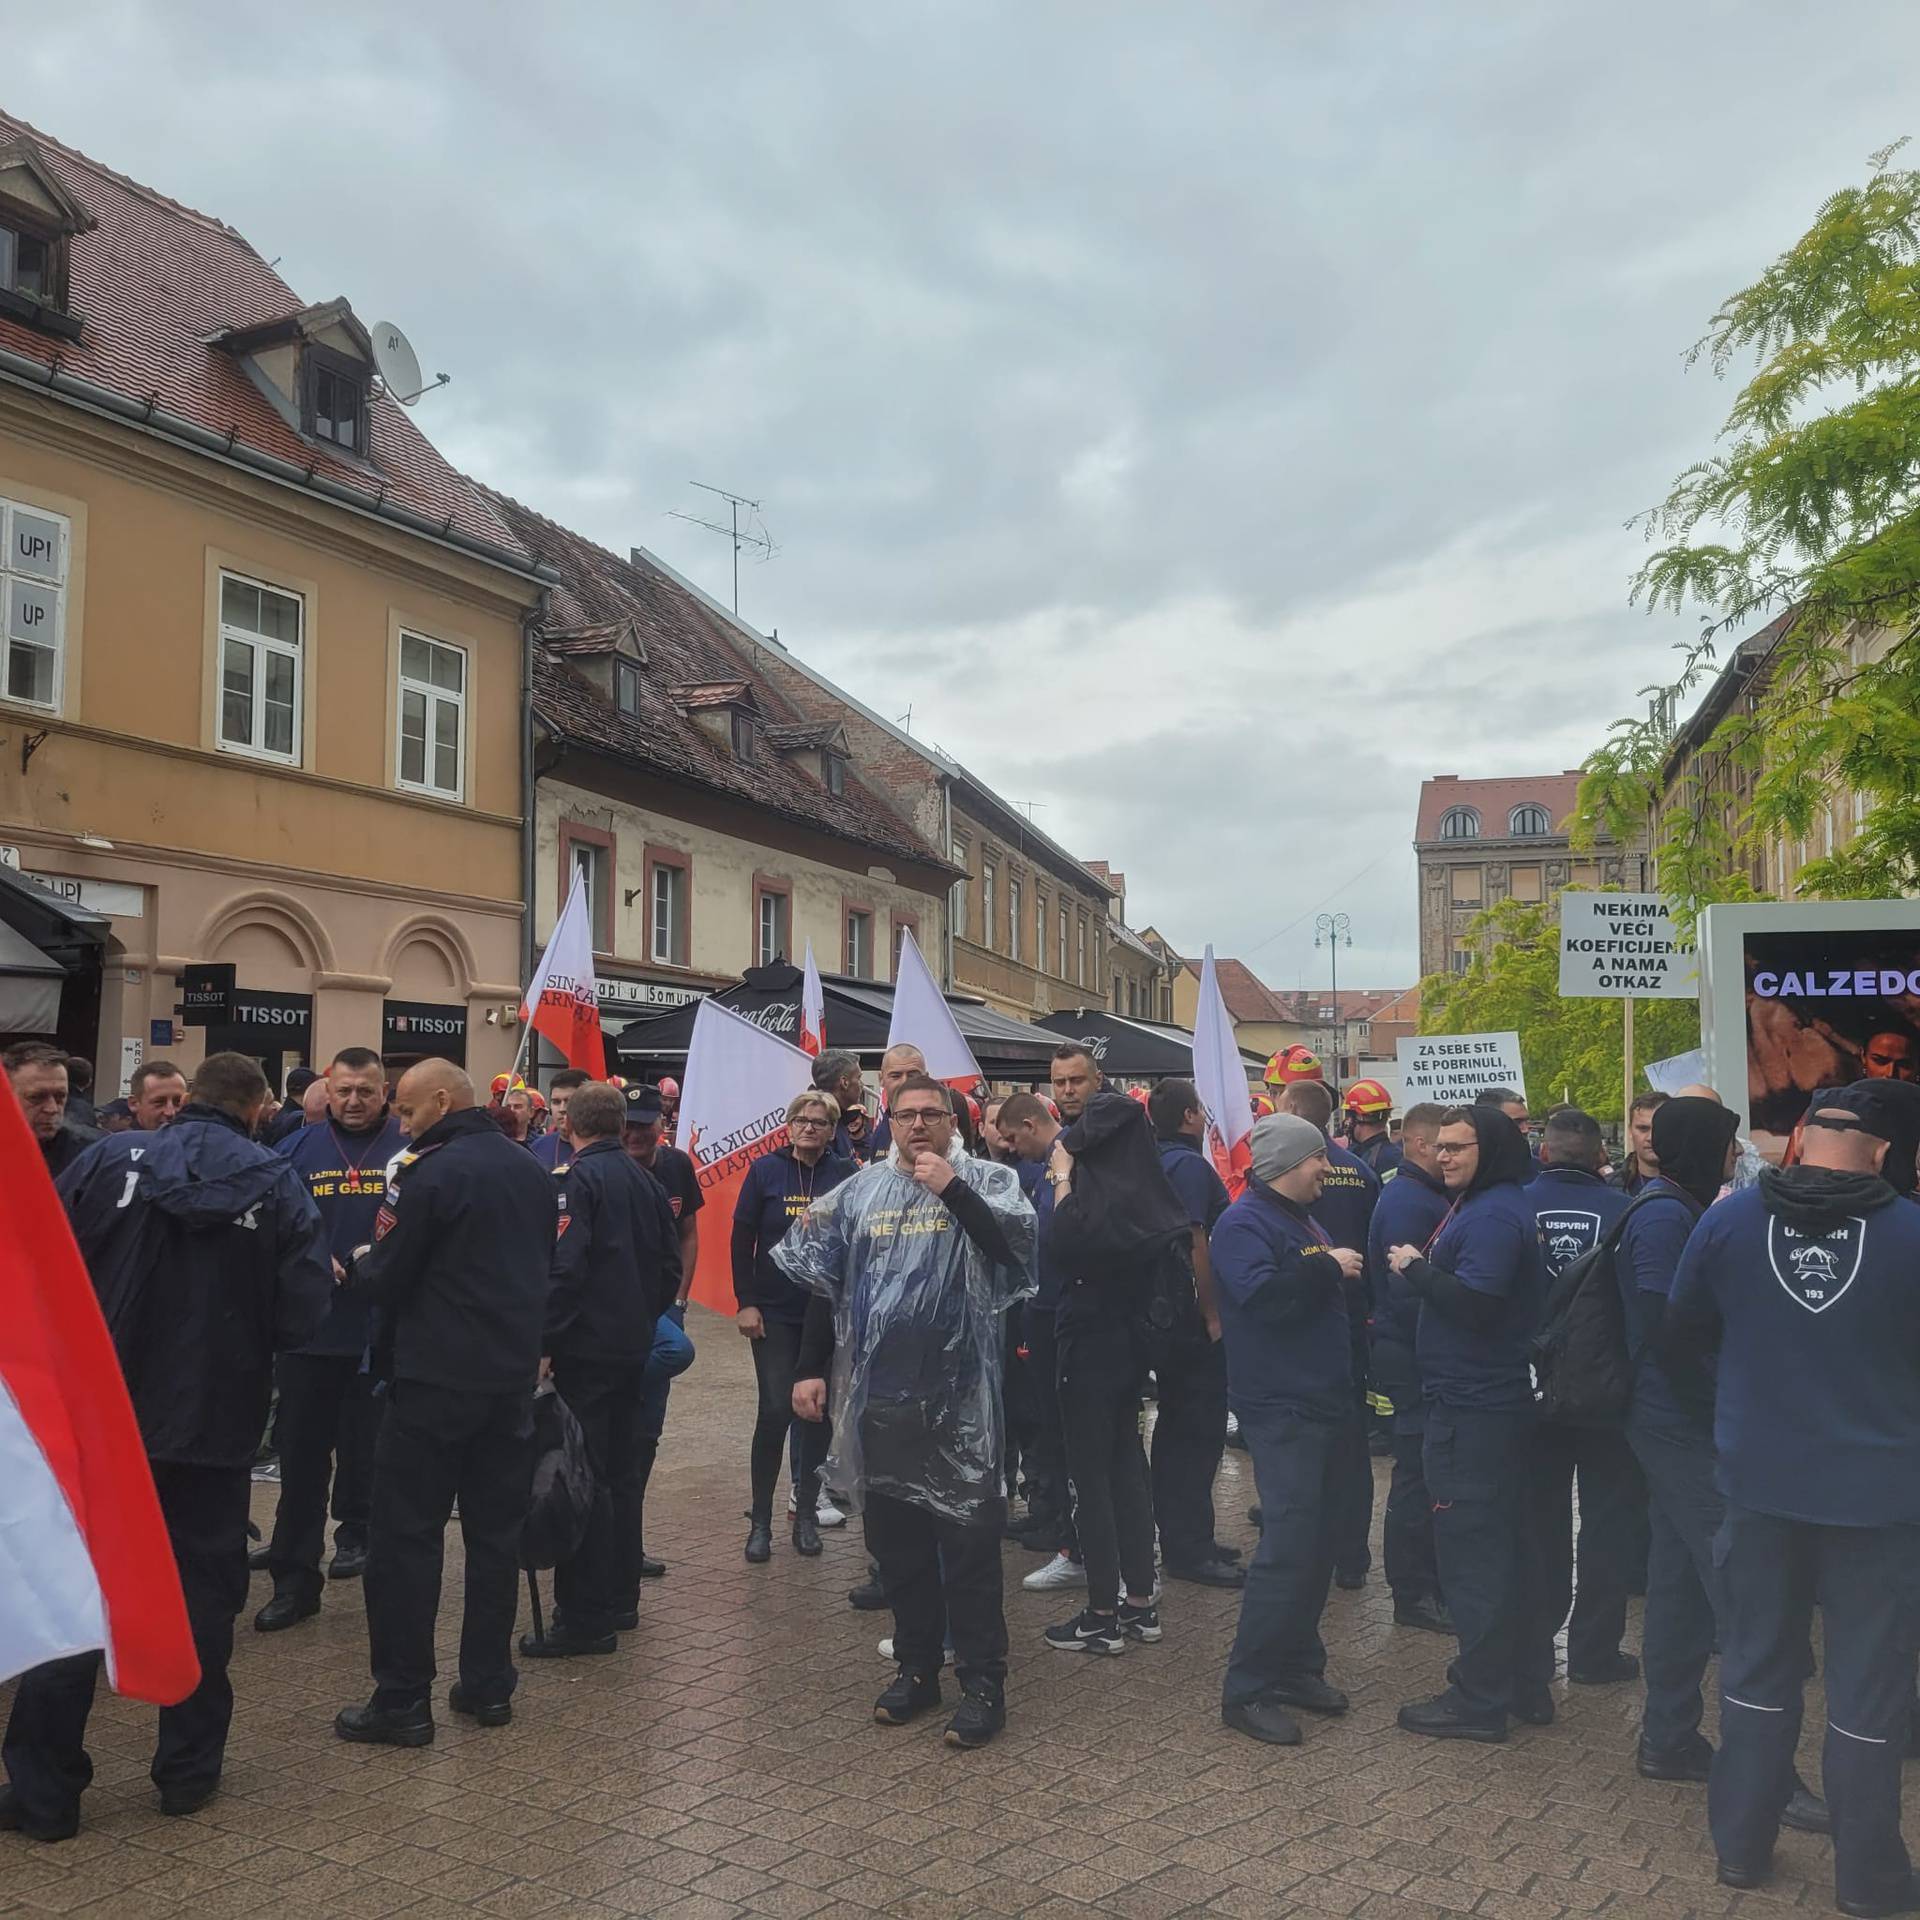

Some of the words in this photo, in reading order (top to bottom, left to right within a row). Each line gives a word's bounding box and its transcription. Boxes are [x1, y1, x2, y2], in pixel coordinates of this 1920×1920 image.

[388, 336, 398, 351] A1
[20, 533, 51, 562] UP!
[23, 603, 45, 626] UP
[1593, 903, 1669, 917] NEKIMA
[1609, 920, 1654, 936] VEĆI
[1592, 957, 1606, 970] A
[1611, 957, 1668, 971] NAMA
[1598, 974, 1662, 989] OTKAZ
[186, 992, 225, 1002] TISSOT
[238, 1006, 309, 1025] TISSOT
[408, 1017, 465, 1035] TISSOT
[1419, 1045, 1435, 1056] ZA
[1438, 1043, 1471, 1055] SEBE
[1474, 1042, 1497, 1054] STE
[1413, 1060, 1429, 1071] SE
[1432, 1057, 1506, 1070] POBRINULI,
[1406, 1077, 1414, 1087] A
[1417, 1075, 1432, 1086] MI
[1436, 1075, 1444, 1085] U
[1448, 1070, 1517, 1085] NEMILOSTI
[1433, 1088, 1485, 1100] LOKALN
[313, 1184, 334, 1197] NE
[339, 1182, 384, 1194] GASE
[785, 1206, 805, 1216] NE
[869, 1223, 894, 1237] NE
[900, 1218, 949, 1235] GASE
[1545, 1221, 1589, 1231] USPVRH
[1804, 1289, 1825, 1299] 193
